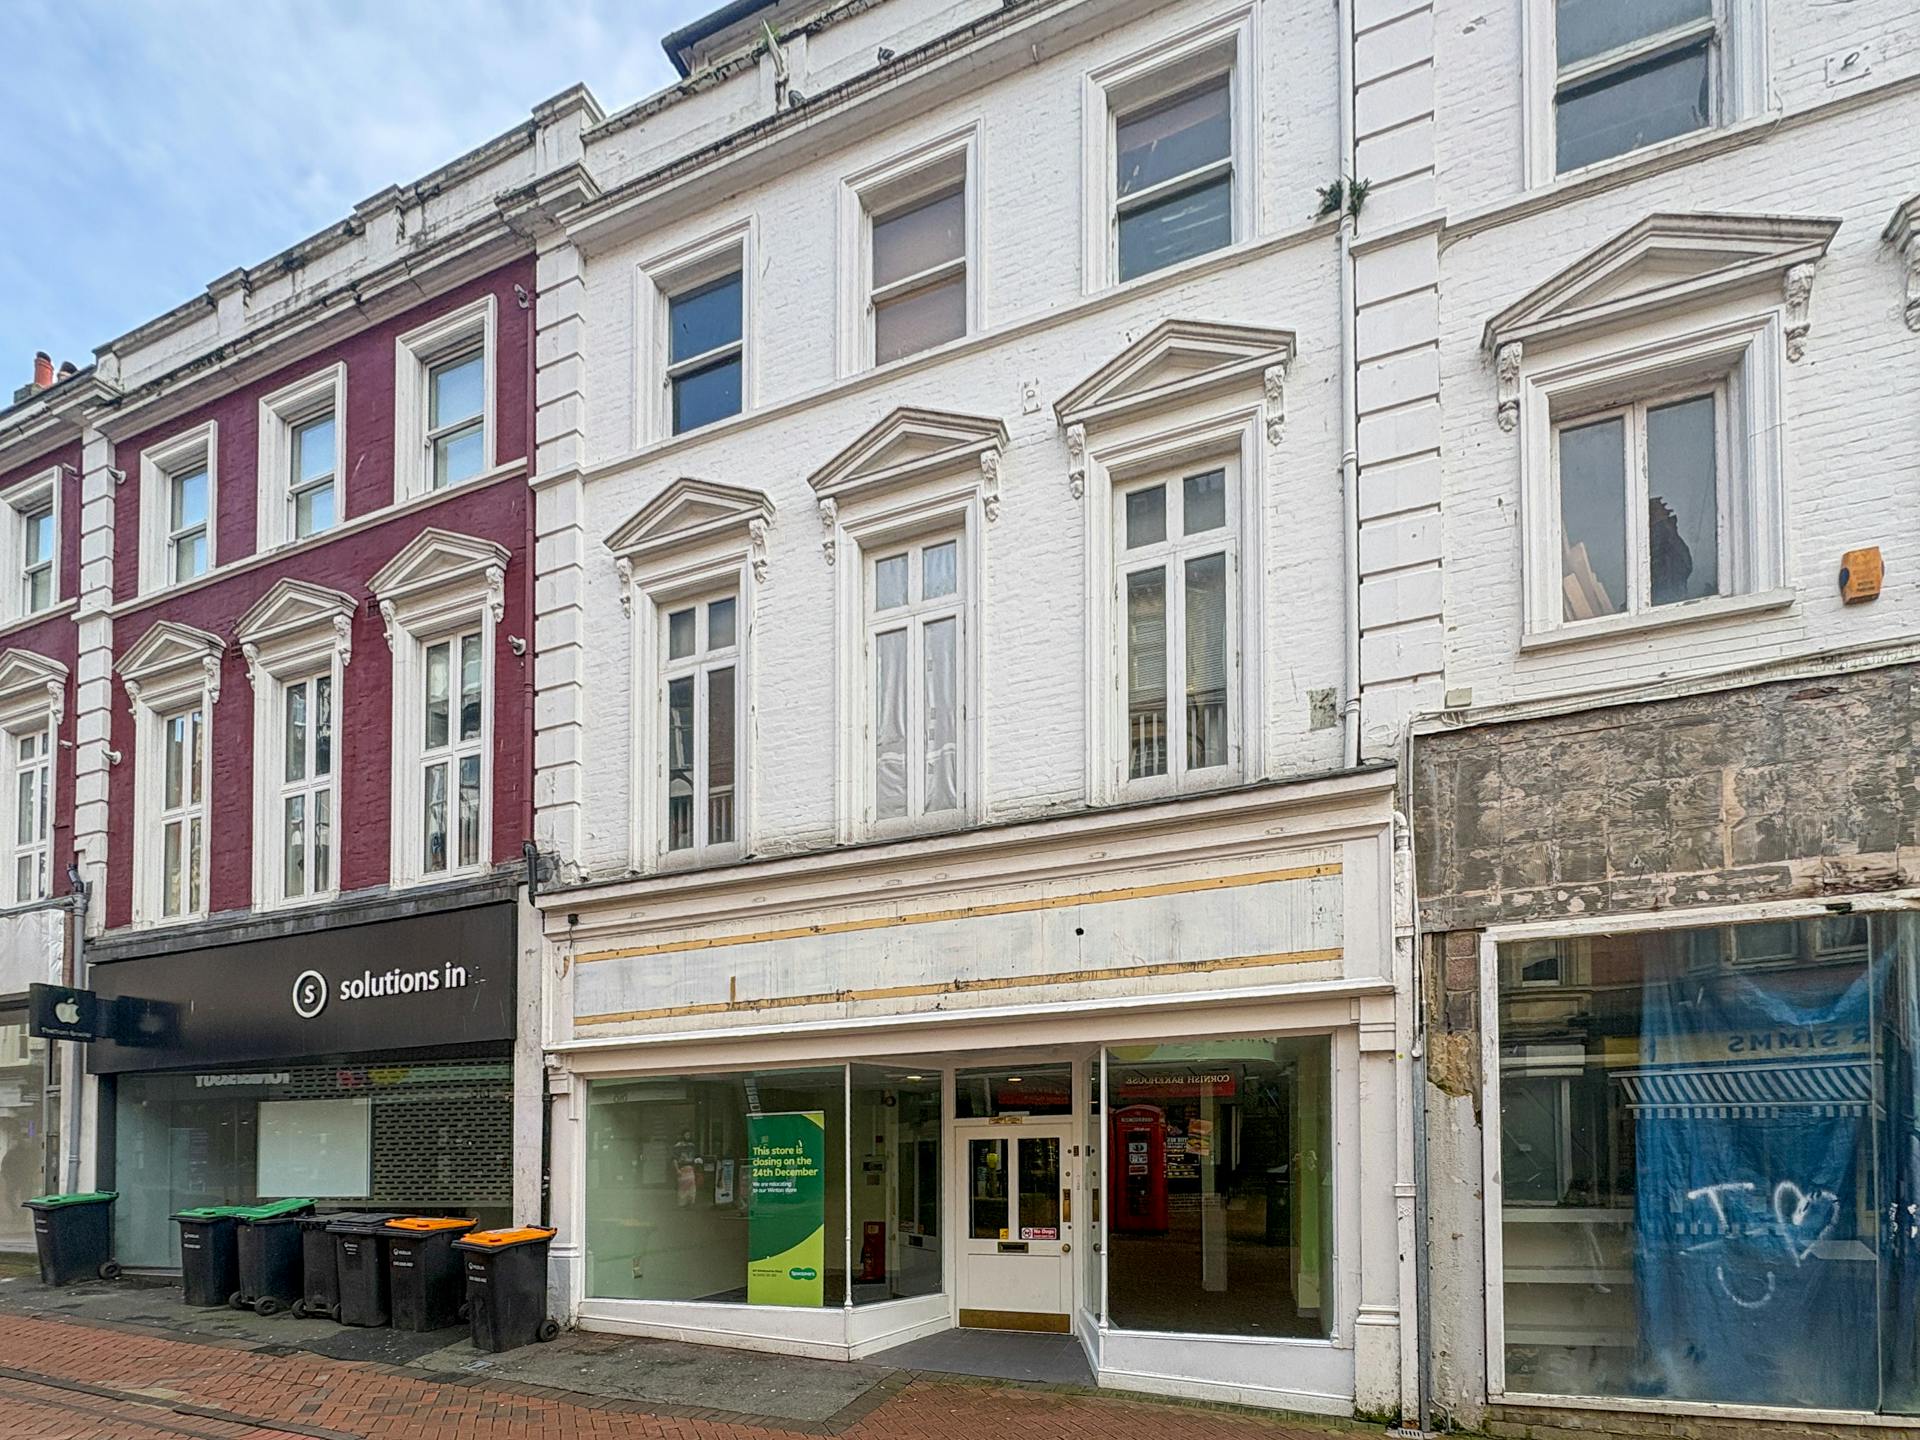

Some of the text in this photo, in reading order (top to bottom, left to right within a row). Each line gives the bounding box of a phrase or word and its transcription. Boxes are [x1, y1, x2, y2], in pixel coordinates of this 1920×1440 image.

[340, 961, 467, 1000] solutions in
[752, 1145, 803, 1155] This store is
[752, 1157, 782, 1168] closing
[796, 1156, 812, 1165] the
[752, 1167, 819, 1177] 24th December
